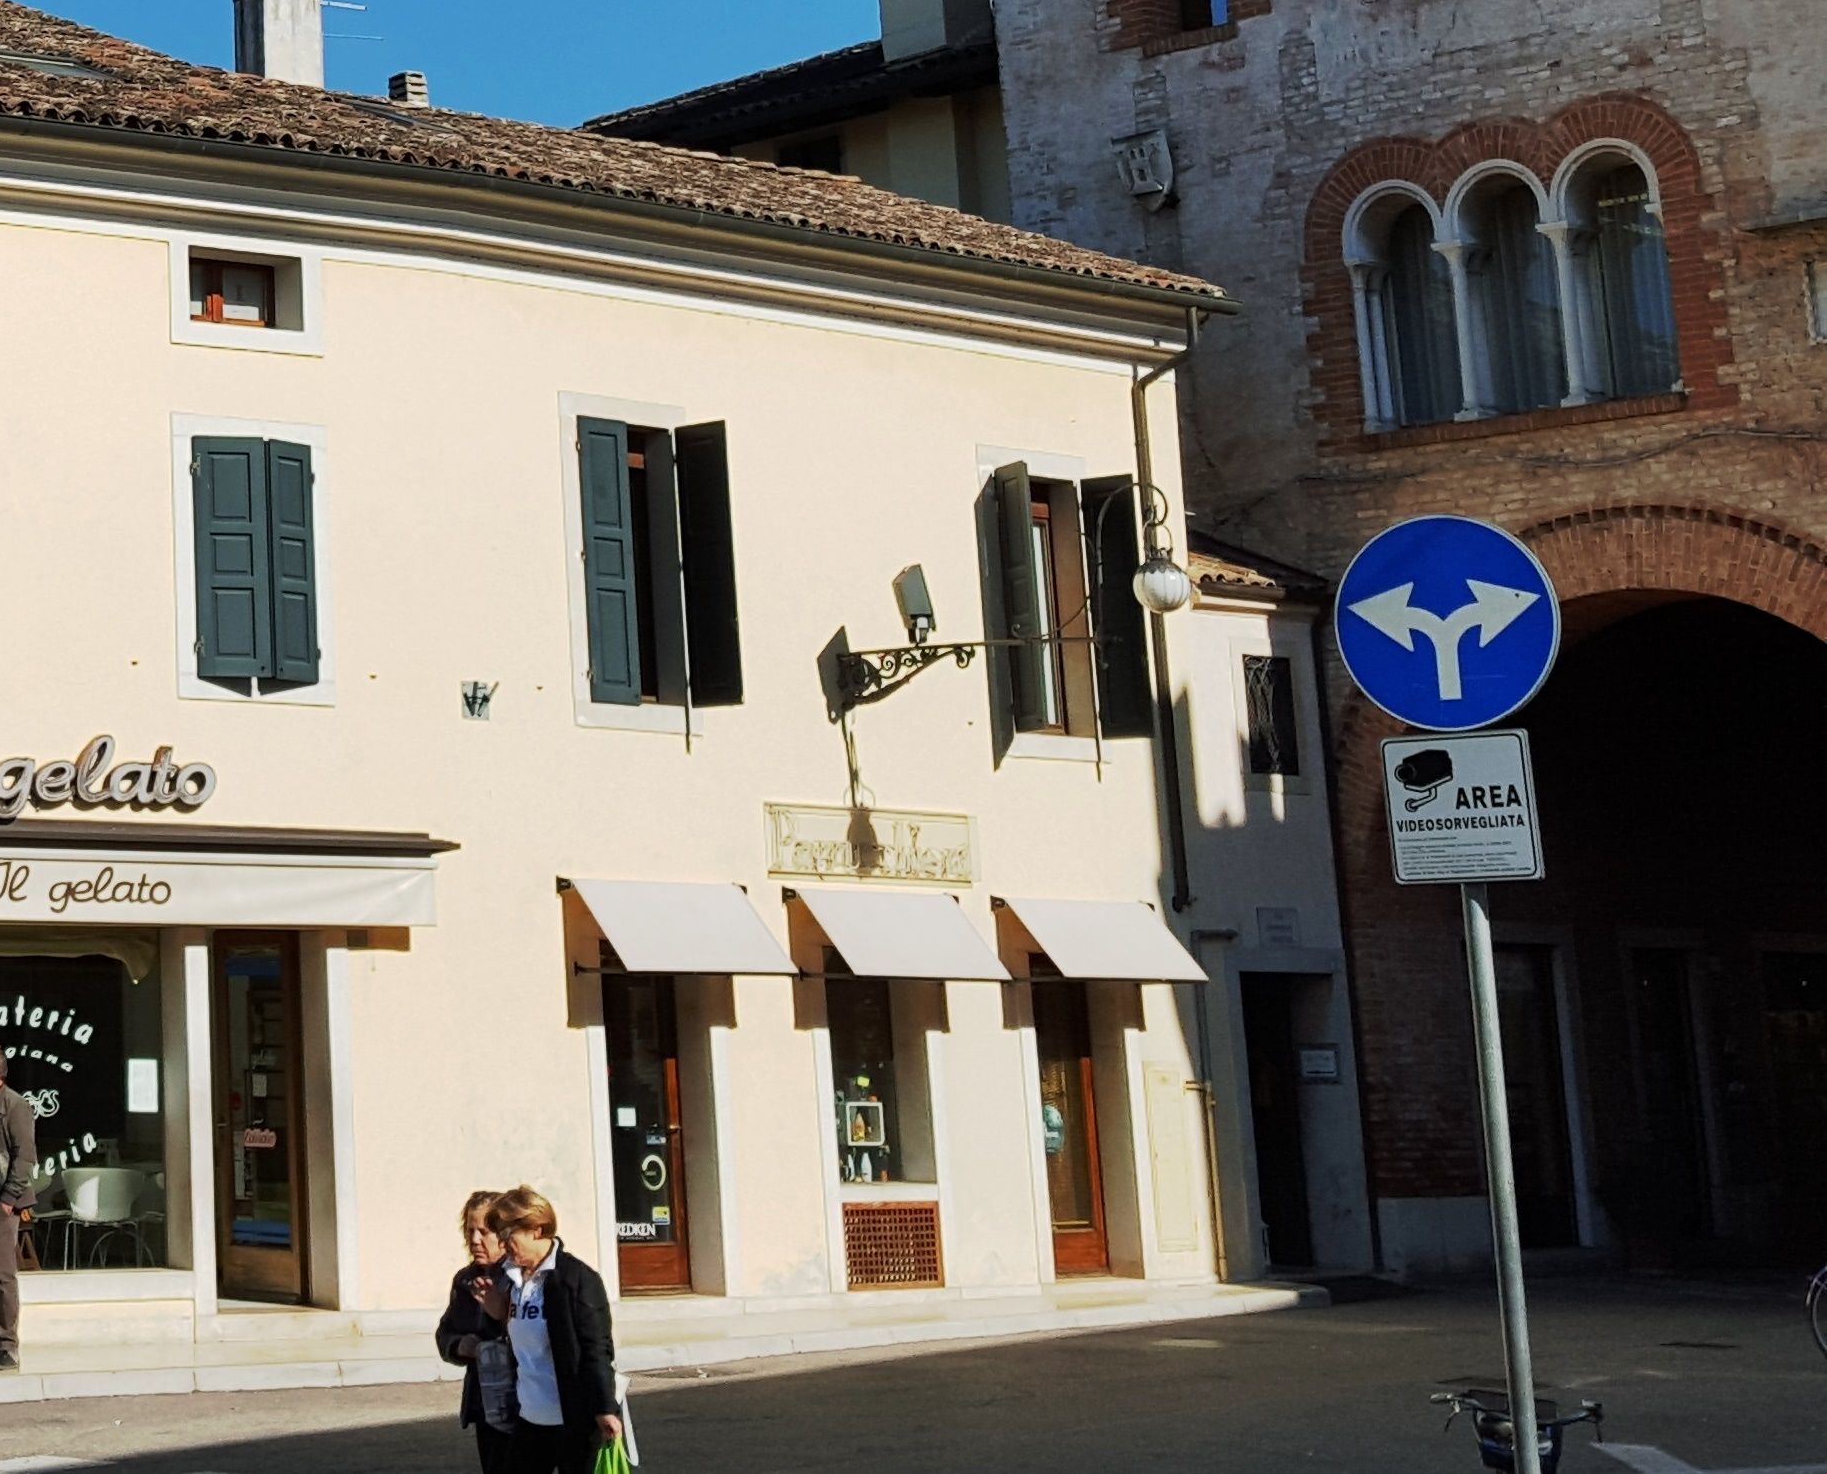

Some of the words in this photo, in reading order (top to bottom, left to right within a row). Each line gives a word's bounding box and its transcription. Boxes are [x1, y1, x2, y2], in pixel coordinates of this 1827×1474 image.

[1455, 784, 1522, 810] AREA
[1396, 814, 1525, 832] VIDEOSORVEGLIATA
[48, 866, 171, 914] gelato
